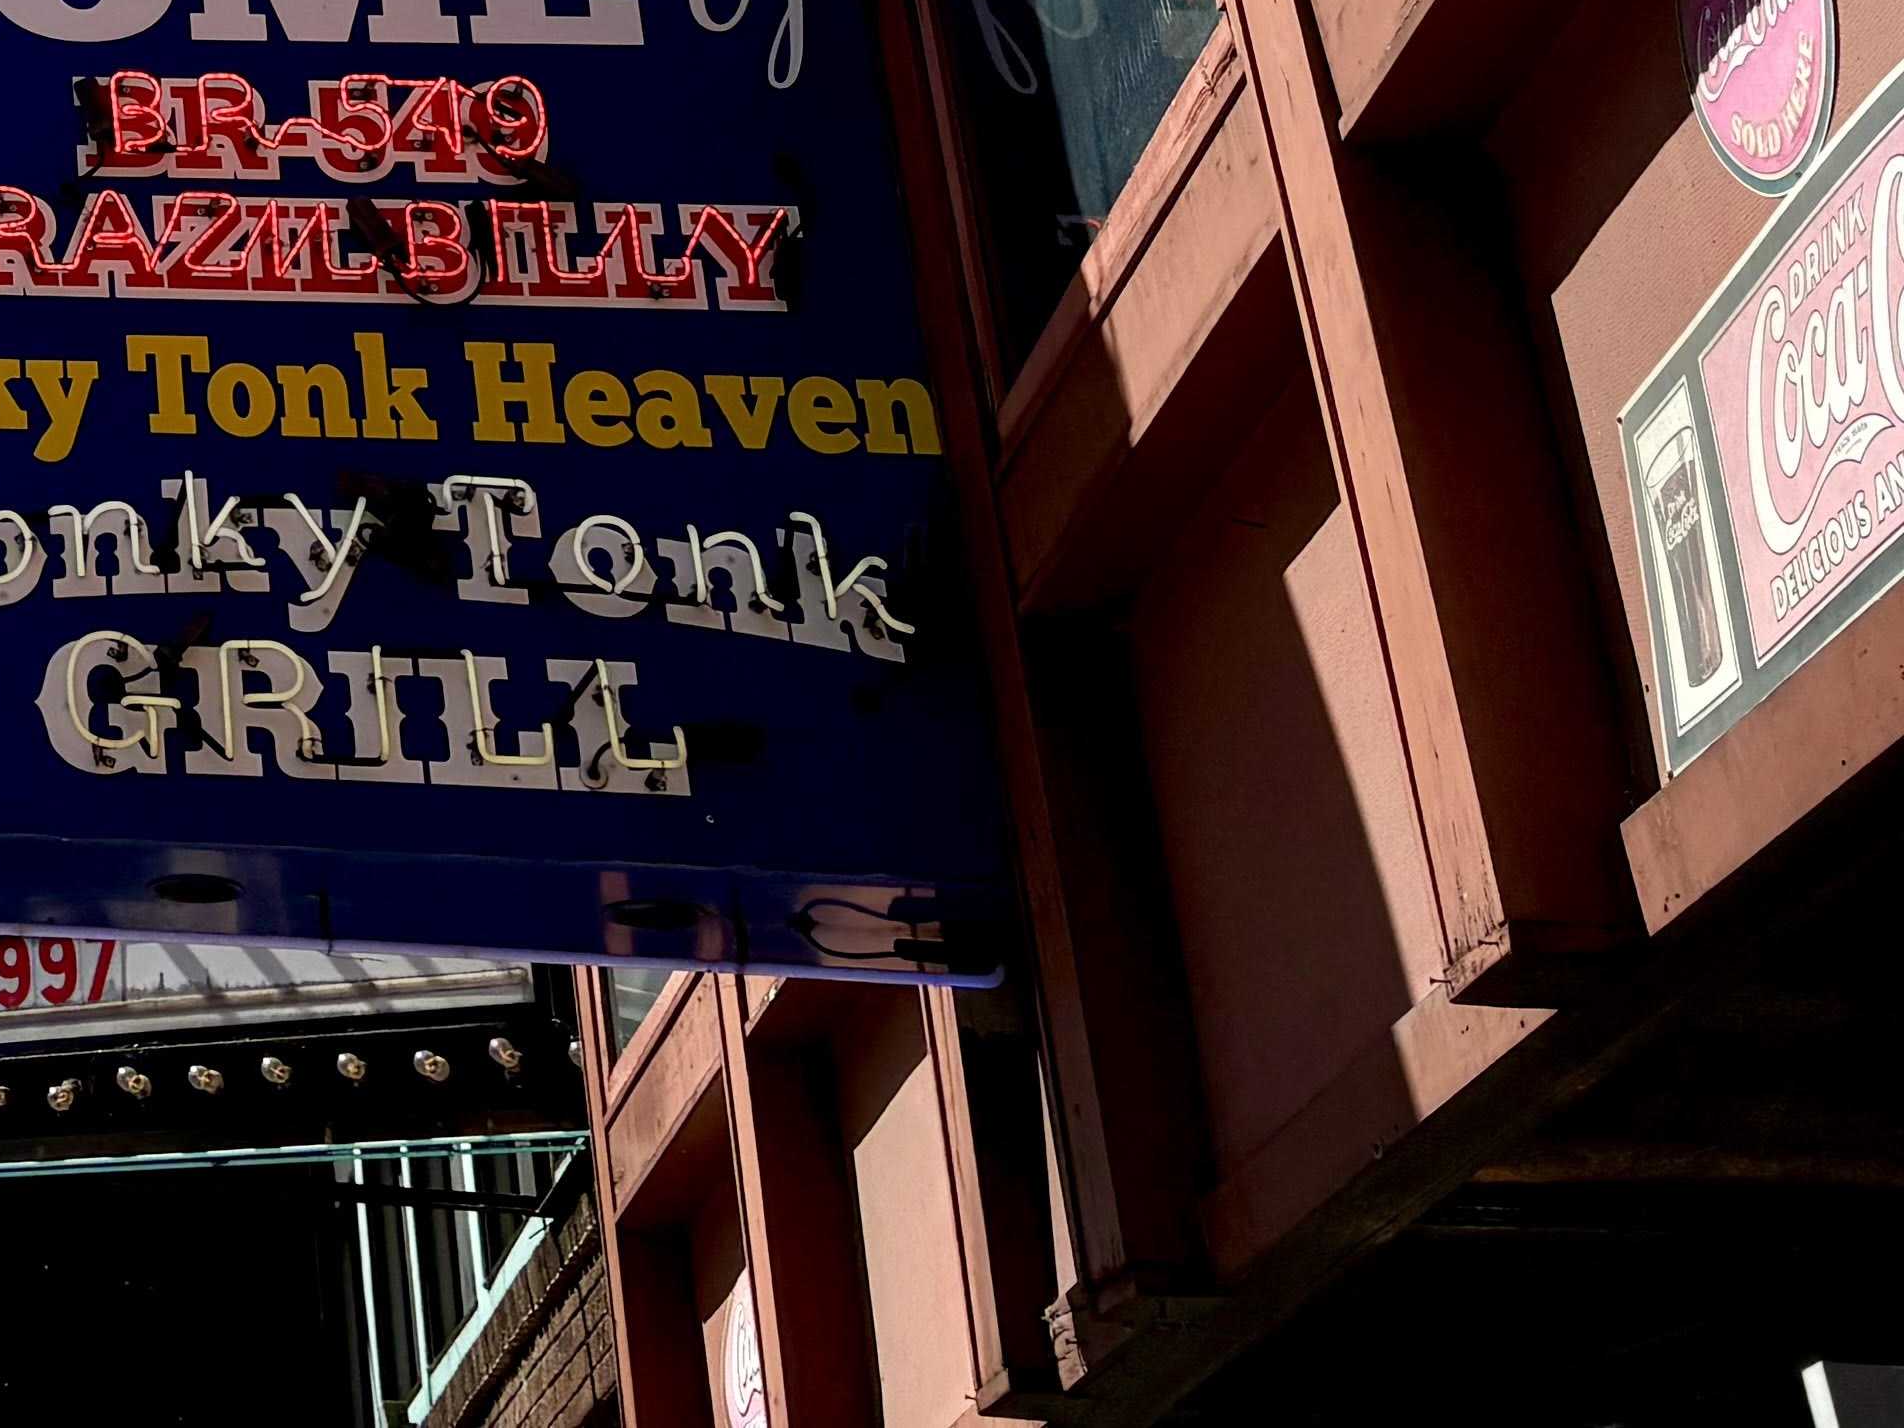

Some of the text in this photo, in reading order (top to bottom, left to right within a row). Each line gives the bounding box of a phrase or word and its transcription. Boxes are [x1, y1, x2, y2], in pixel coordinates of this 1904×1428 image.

[1729, 29, 1814, 159] SOLD HERE
[1789, 182, 1868, 316] DRINK
[126, 332, 439, 441] Tonk
[463, 341, 944, 455] Heaven
[426, 474, 916, 664] Tonk
[1769, 490, 1874, 623] DELICIOUS
[34, 630, 692, 796] GRILL
